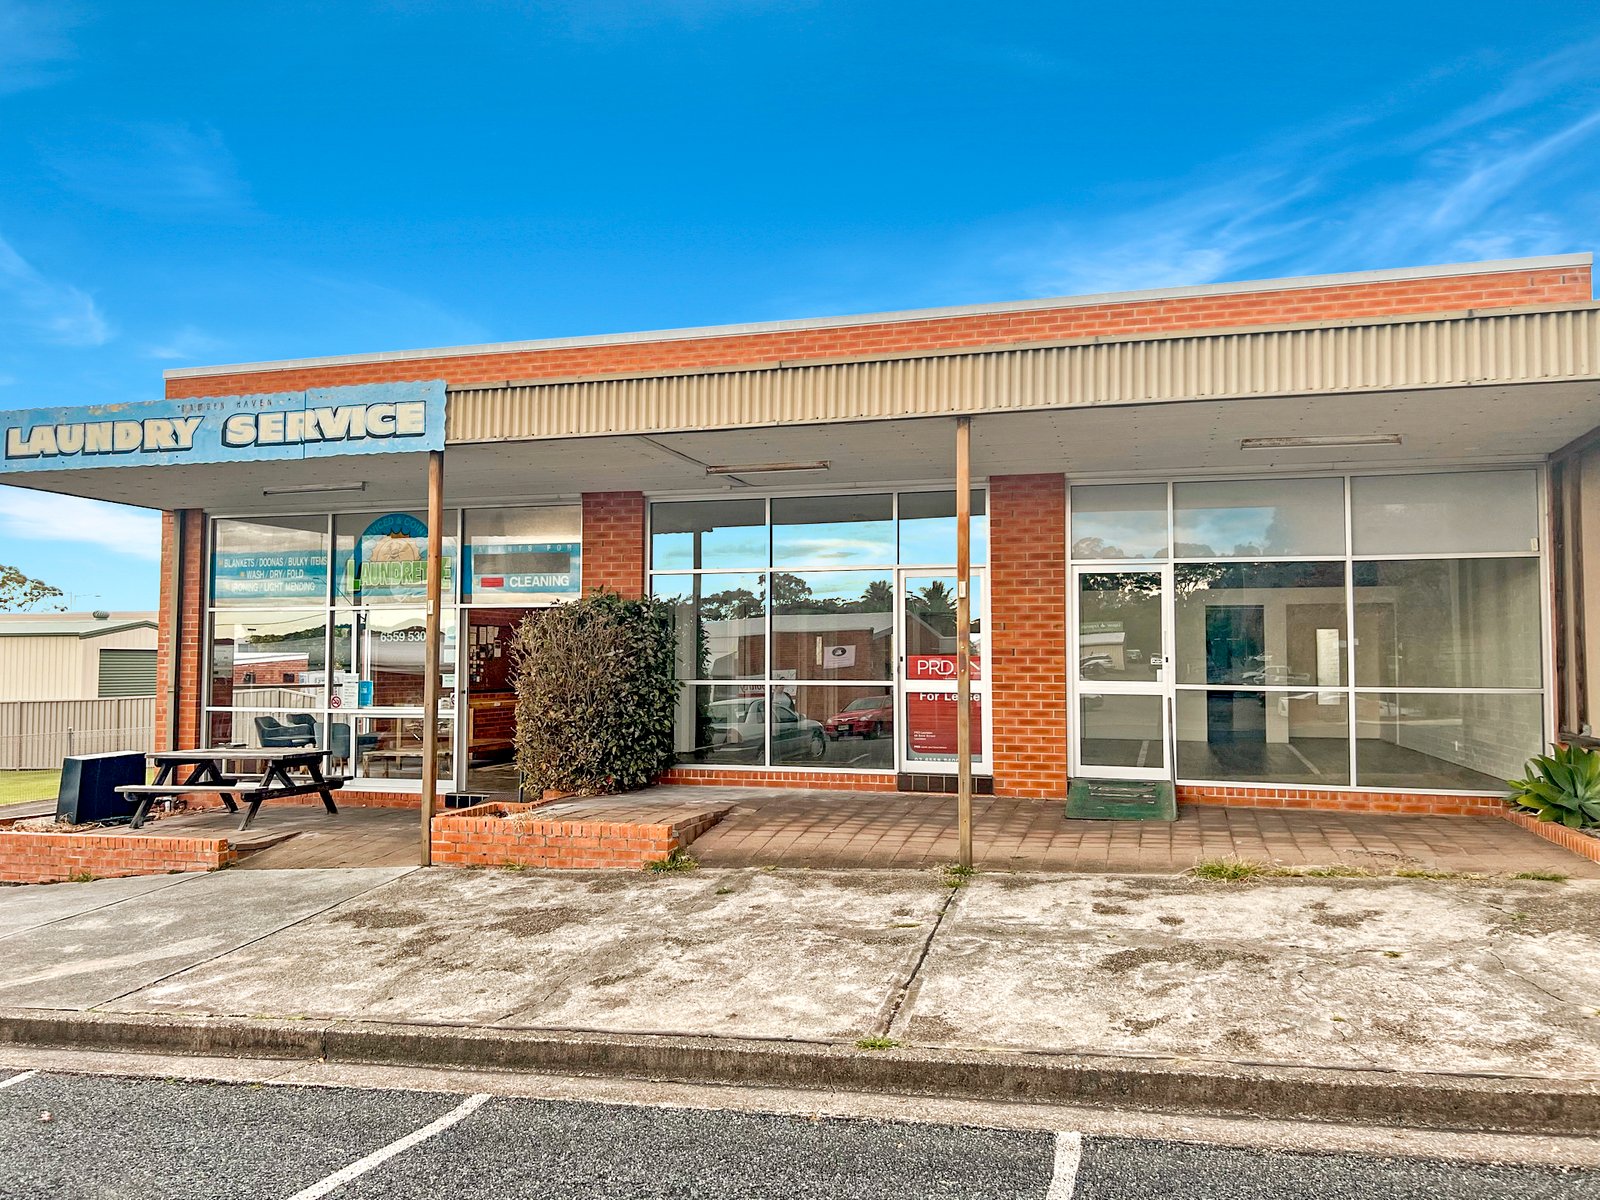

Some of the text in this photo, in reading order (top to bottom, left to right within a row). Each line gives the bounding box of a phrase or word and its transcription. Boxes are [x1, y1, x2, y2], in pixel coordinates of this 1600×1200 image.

[236, 399, 272, 408] HAVEN
[5, 401, 426, 459] LAUNDRY SERVICE
[224, 558, 255, 568] BLANKETS
[259, 557, 284, 567] DOONAS
[288, 556, 308, 566] BULKY
[311, 556, 328, 565] ITEMS
[246, 570, 265, 579] WASH
[269, 570, 283, 579] DRY
[287, 569, 304, 578] FOLD
[346, 556, 452, 592] LAUNDRETE
[509, 575, 570, 587] CLEANING
[231, 582, 259, 592] IRONING
[264, 582, 283, 592] LIGHT
[285, 582, 316, 591] MENDING
[380, 631, 427, 642] 6559 530
[919, 693, 981, 701] For Lee
